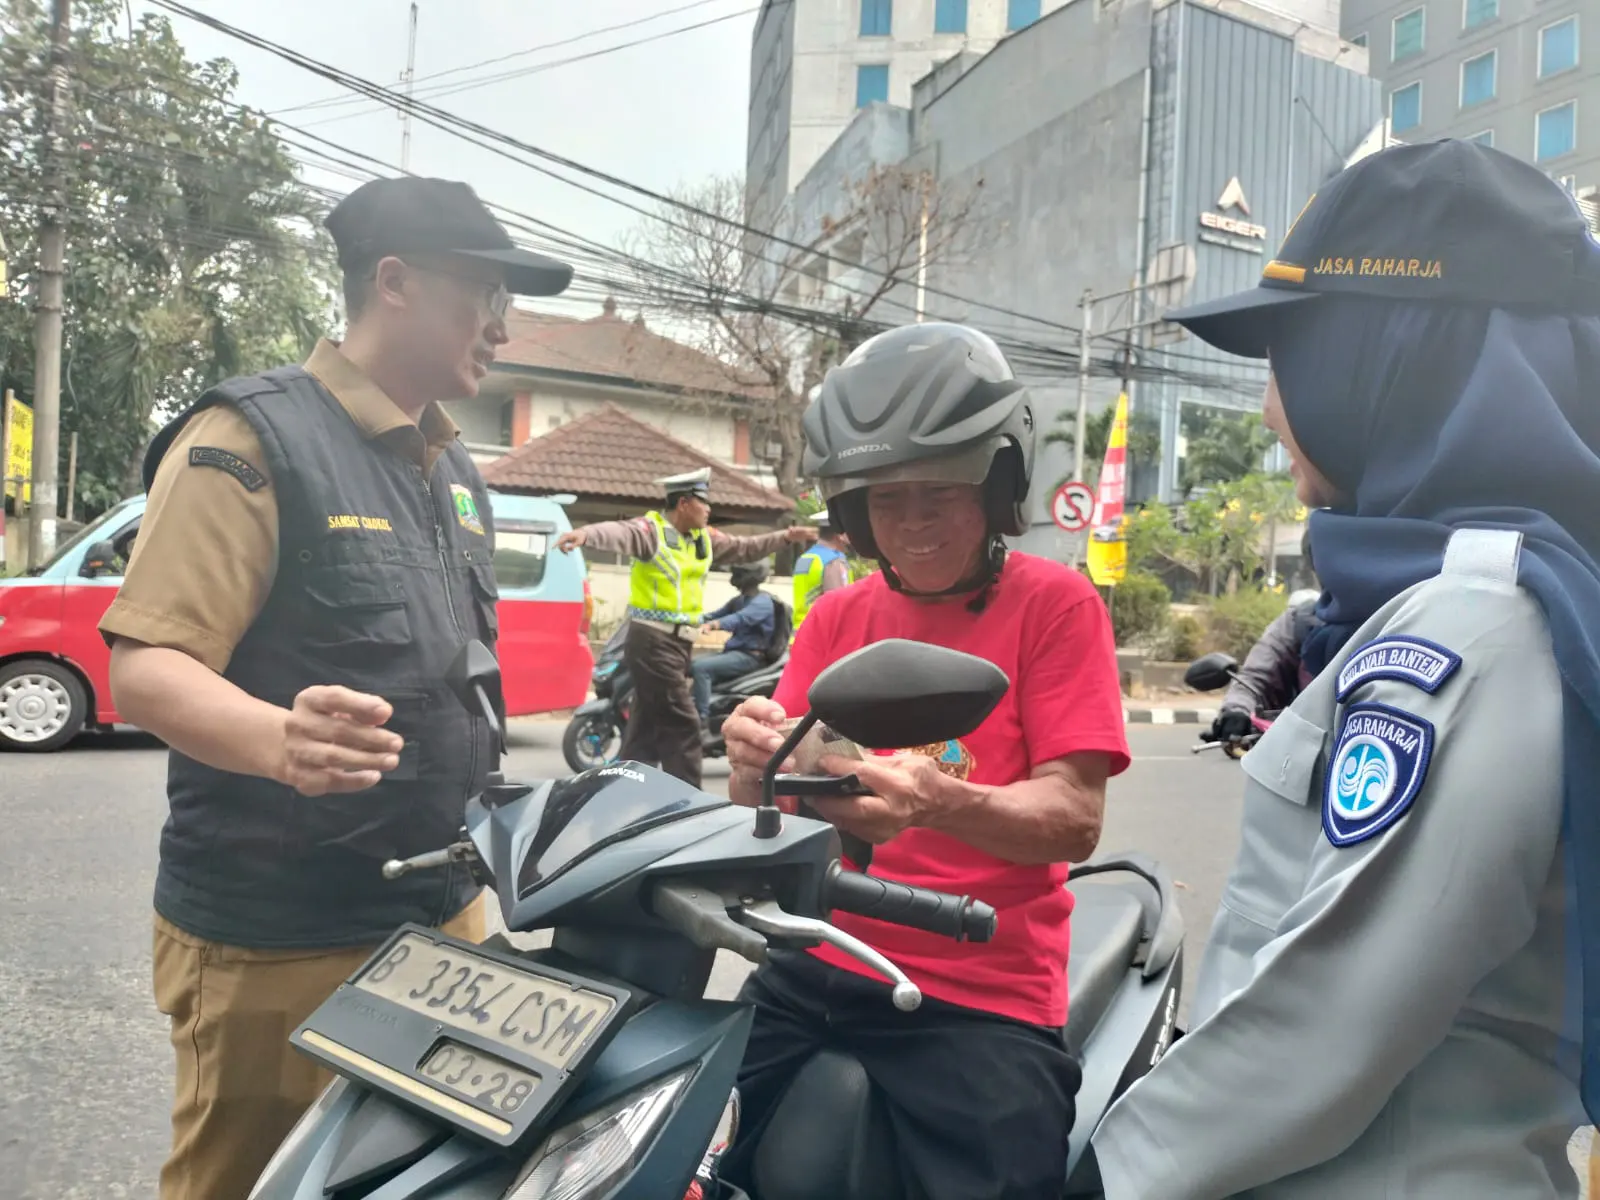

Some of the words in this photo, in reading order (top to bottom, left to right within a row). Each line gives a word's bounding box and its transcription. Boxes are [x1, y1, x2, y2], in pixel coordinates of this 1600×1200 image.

[1200, 211, 1266, 239] EIGER
[1314, 258, 1354, 275] JASA
[1359, 258, 1442, 279] RAHARJA
[837, 443, 892, 460] HONDA
[328, 514, 360, 529] SAMSAT
[1388, 648, 1442, 678] BANTEN
[1363, 717, 1419, 755] RAHARJA
[598, 767, 645, 783] HONDA
[367, 943, 411, 983] B
[499, 990, 598, 1057] CSM
